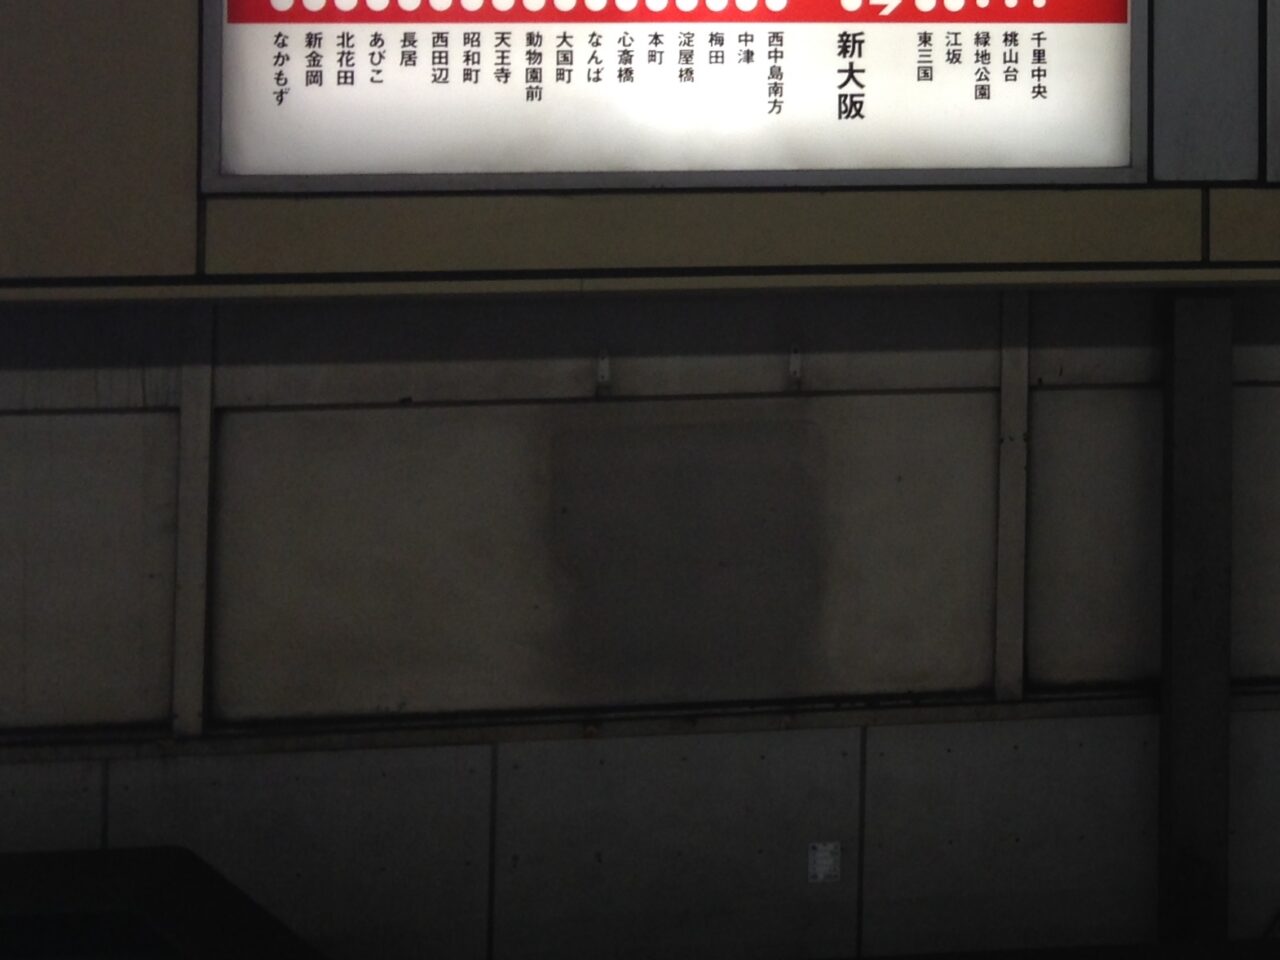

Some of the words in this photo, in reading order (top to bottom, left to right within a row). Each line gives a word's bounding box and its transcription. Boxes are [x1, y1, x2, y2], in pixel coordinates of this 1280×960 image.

[273, 31, 291, 106] なかもず
[305, 31, 323, 87] 新金岡
[336, 31, 355, 86] 北花田
[369, 31, 386, 84] あびこ
[400, 31, 418, 67] 長居
[431, 31, 449, 84] 西田辺
[463, 31, 481, 84] 昭和町
[493, 31, 512, 84] 天王寺
[525, 31, 543, 102] 動物園前
[555, 31, 574, 84] 大国町
[587, 31, 604, 83] なんば
[617, 31, 635, 84] 心斎橋
[647, 31, 664, 65] 本町
[678, 31, 695, 83] 淀屋橋
[708, 31, 725, 65] 梅田
[737, 31, 755, 64] 中津
[767, 31, 784, 115] 西中島南方
[916, 31, 934, 82] 東三国
[945, 31, 962, 65] 江坂
[974, 31, 991, 100] 緑地公園
[1002, 31, 1019, 82] 桃山台
[1031, 31, 1048, 100] 千里中央
[837, 30, 866, 120] 新大阪
